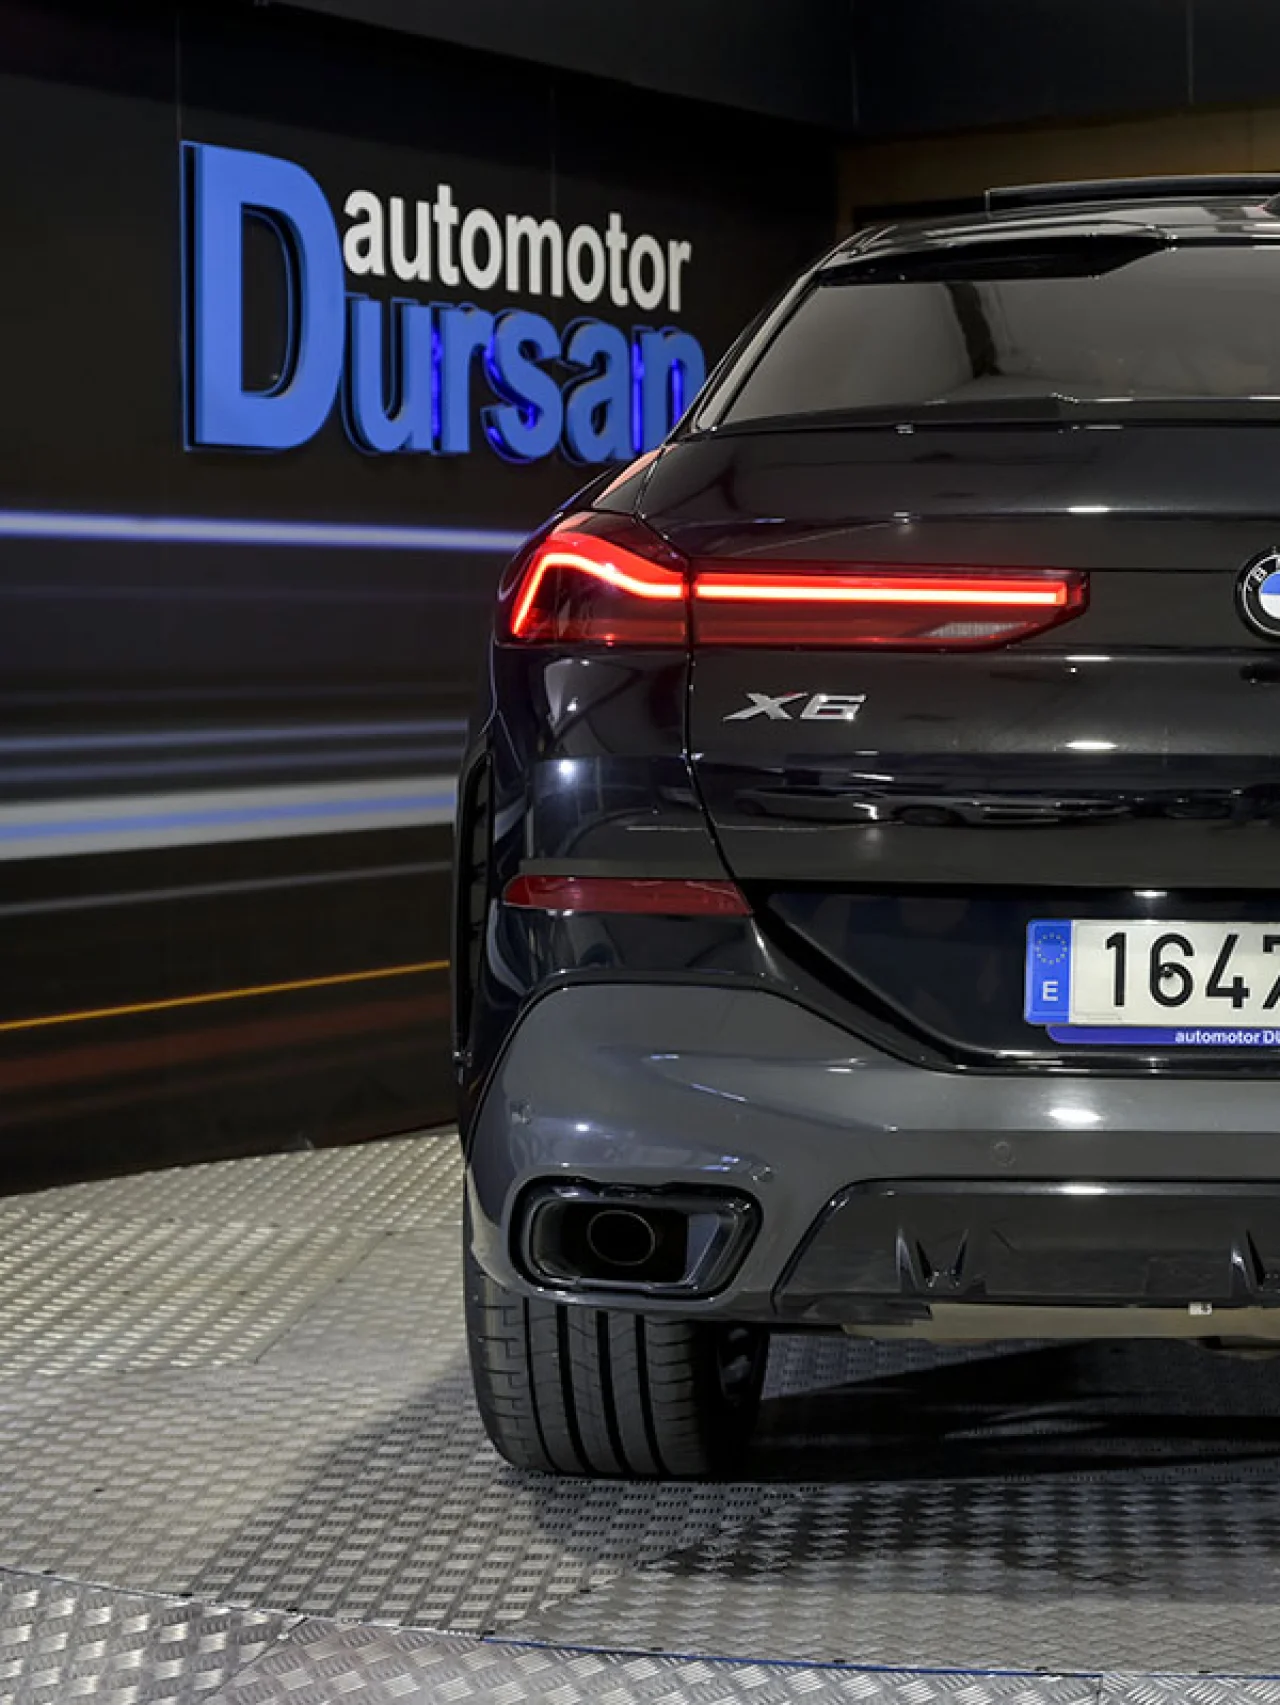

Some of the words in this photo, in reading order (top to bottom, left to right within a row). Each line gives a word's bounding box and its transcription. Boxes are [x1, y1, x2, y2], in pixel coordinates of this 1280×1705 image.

[343, 184, 692, 312] automotor
[180, 140, 706, 464] Dursan
[722, 692, 867, 721] X6
[1042, 980, 1059, 1001] E
